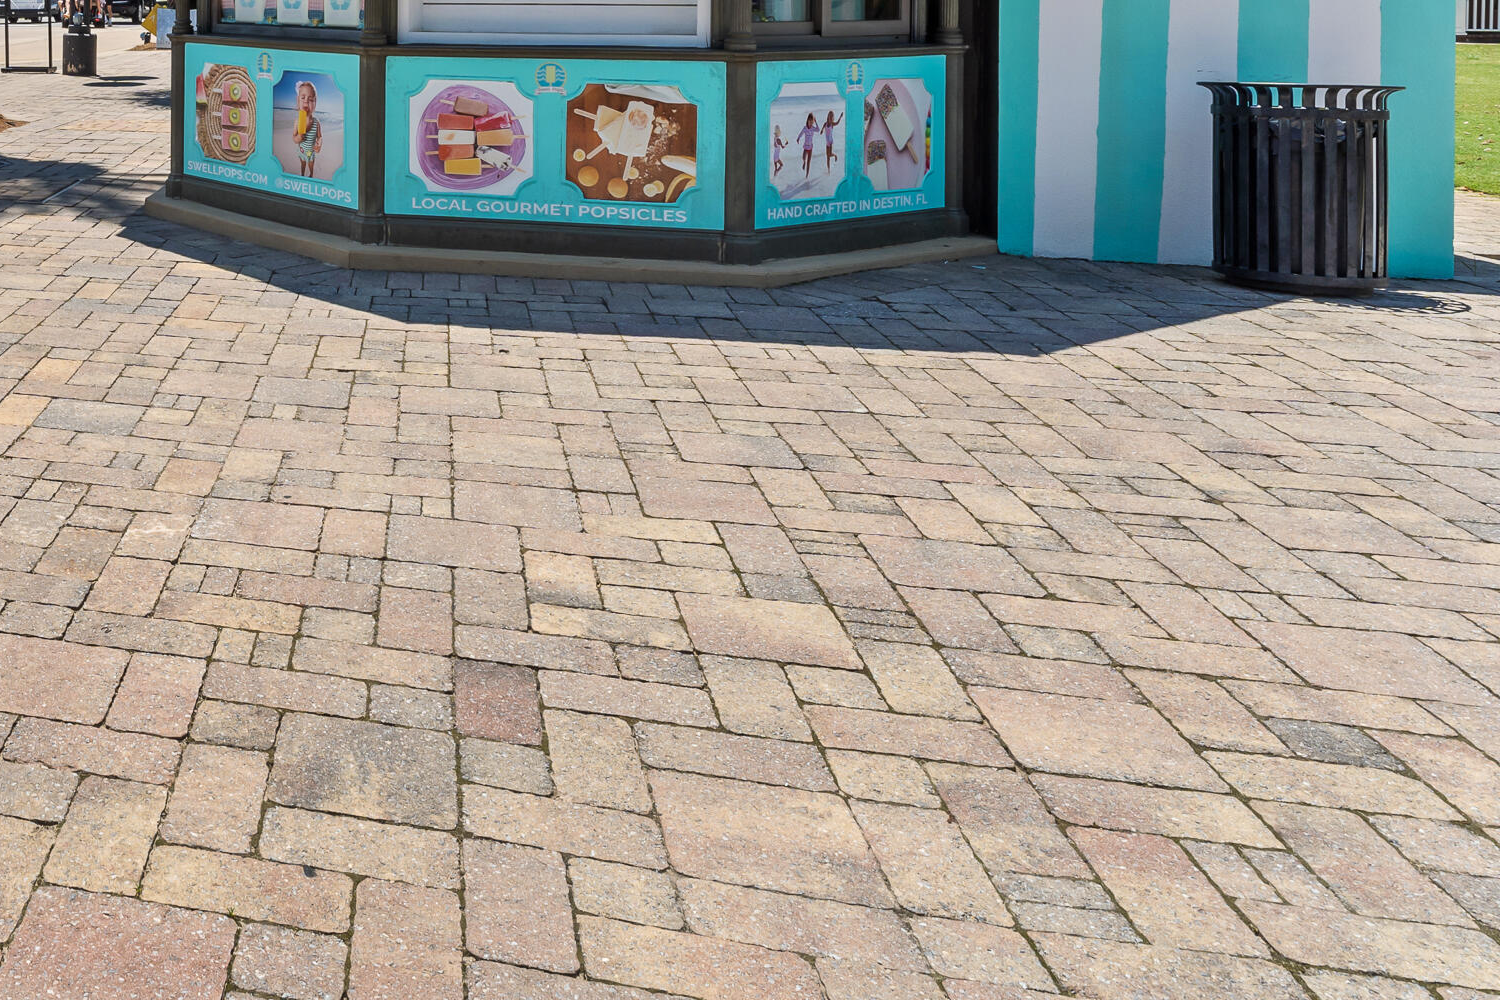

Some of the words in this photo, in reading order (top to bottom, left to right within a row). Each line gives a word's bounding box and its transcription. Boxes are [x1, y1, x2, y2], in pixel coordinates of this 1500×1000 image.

[187, 160, 268, 185] SWELLPOPS.COM
[275, 177, 352, 203] @SWELLPOPS
[411, 197, 473, 213] LOCAL
[476, 200, 574, 217] GOURMET
[578, 205, 688, 224] POPSICLES
[767, 205, 802, 221] HAND
[805, 201, 856, 217] CRAFTED
[859, 199, 871, 212] IN
[915, 193, 928, 205] FL
